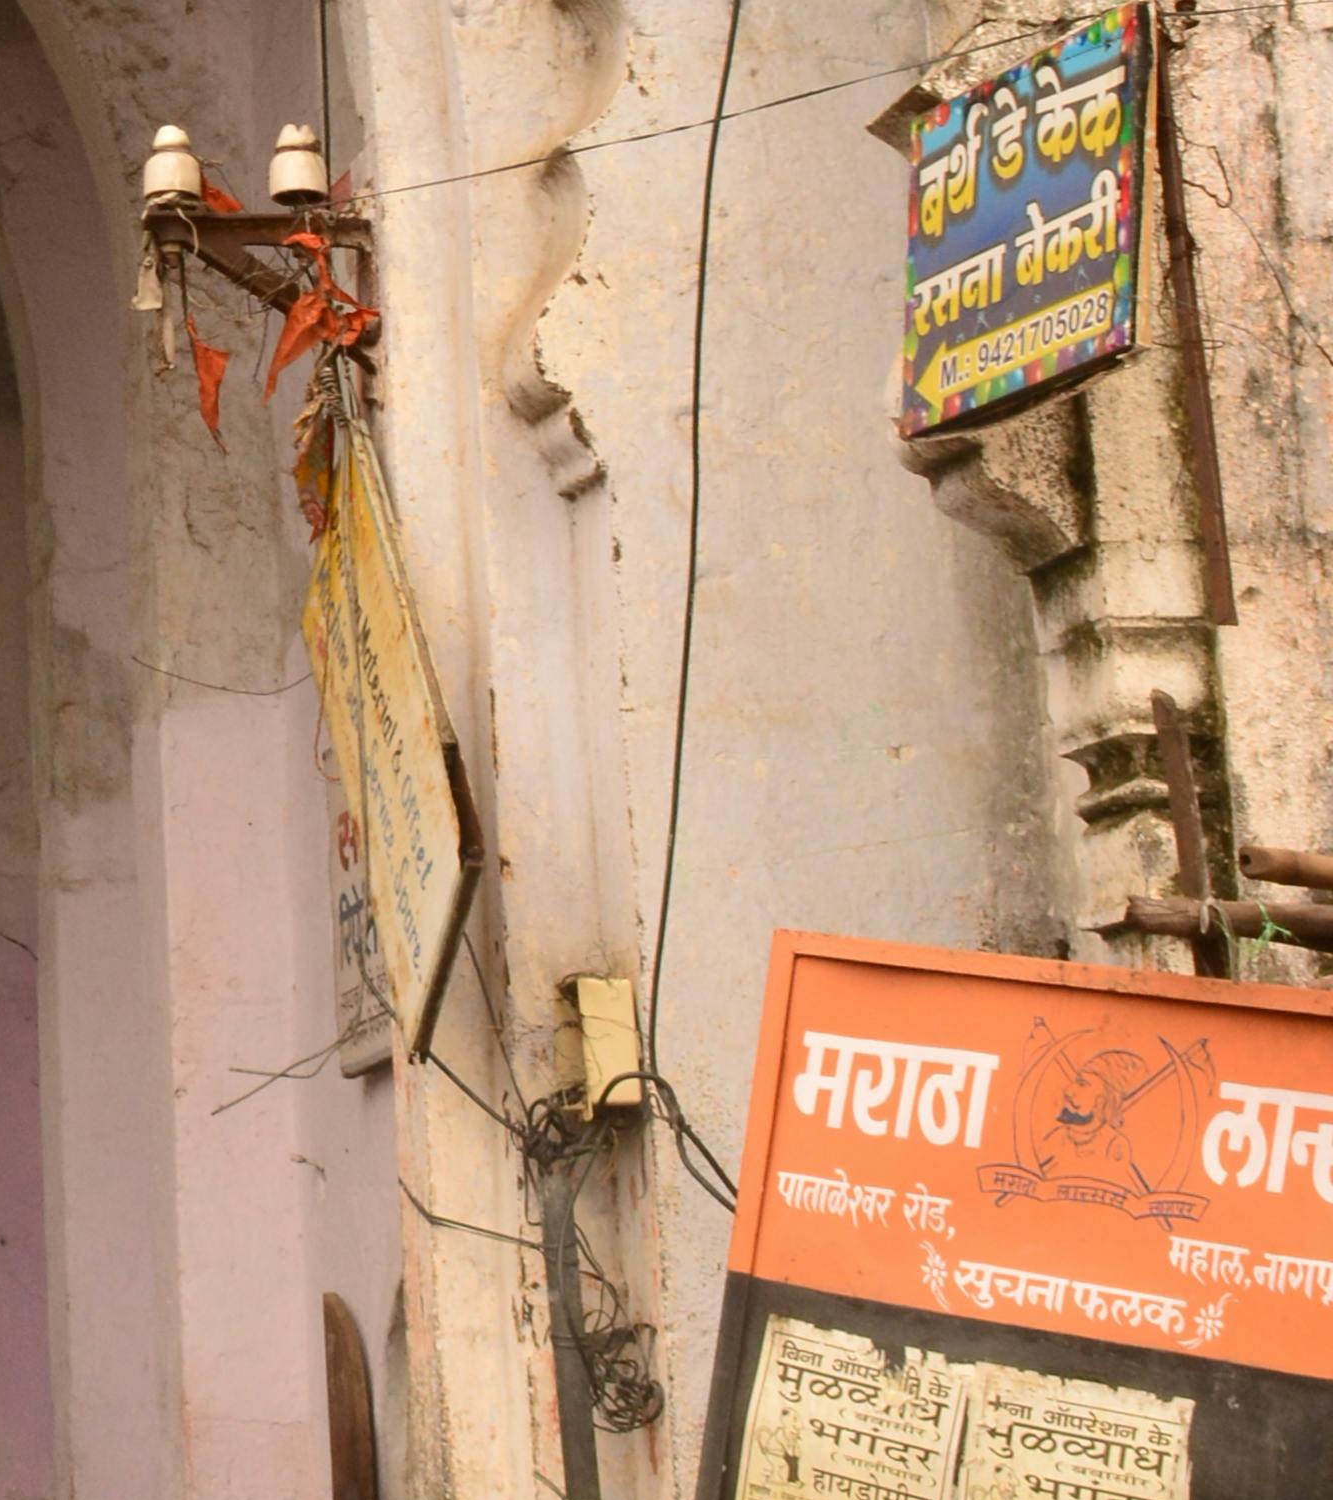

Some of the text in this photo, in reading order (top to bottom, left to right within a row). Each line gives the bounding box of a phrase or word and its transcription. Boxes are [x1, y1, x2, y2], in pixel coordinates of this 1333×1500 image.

[919, 65, 1125, 237] बर्थ डे केक
[913, 169, 1121, 336] रसना बेकरी
[978, 292, 1109, 373] 9421705028
[794, 1031, 1000, 1149] मराठा
[777, 1168, 956, 1240] पाताळेश्वर रोड,
[782, 1339, 823, 1367] बिना
[809, 1418, 940, 1471] भगंदर
[1043, 1406, 1137, 1441] ऑपरेशन
[1148, 1423, 1173, 1447] के
